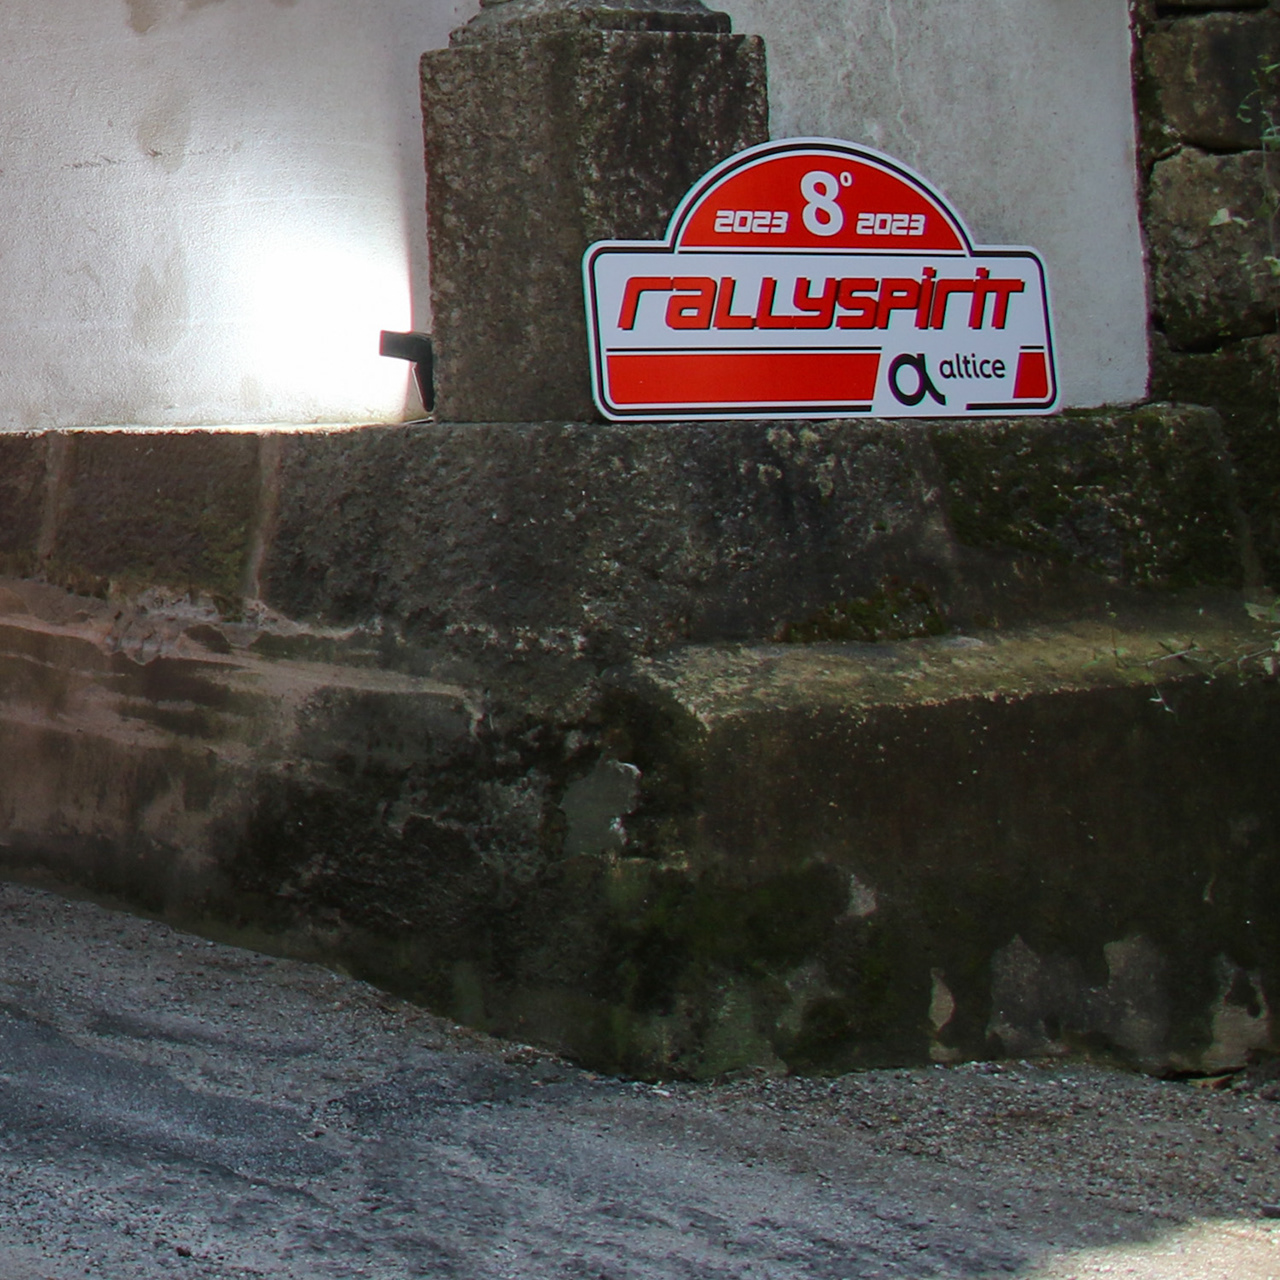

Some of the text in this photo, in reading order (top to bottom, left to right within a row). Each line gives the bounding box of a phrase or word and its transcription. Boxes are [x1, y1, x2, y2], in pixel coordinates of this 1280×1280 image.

[714, 210, 788, 233] 2023
[856, 213, 926, 236] 2023
[940, 354, 1006, 379] altice
